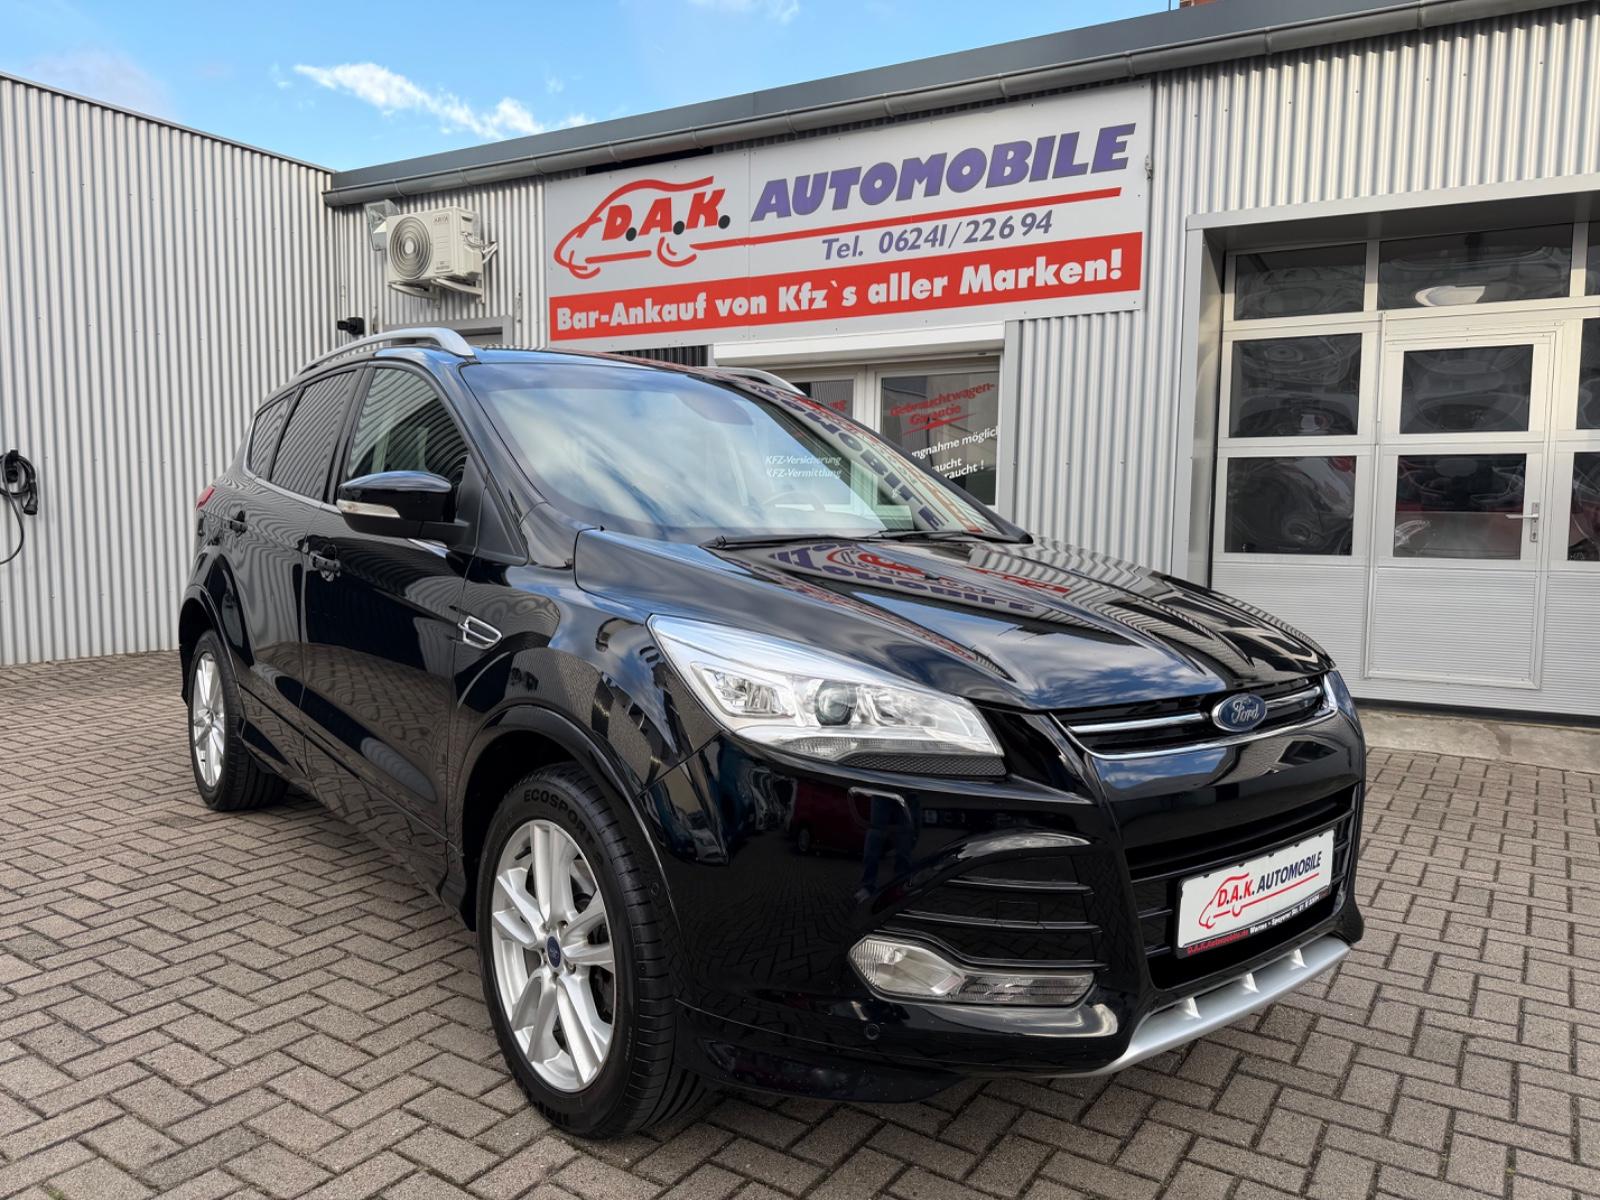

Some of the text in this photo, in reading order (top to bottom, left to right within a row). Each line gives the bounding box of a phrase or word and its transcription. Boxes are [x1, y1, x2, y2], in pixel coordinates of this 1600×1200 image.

[602, 122, 1137, 242] D.A.K. AUTOMOBILE
[822, 235, 864, 260] Tel.
[557, 292, 707, 331] Bar-Ankauf
[715, 295, 767, 317] von
[868, 271, 948, 304] aller
[959, 248, 1123, 295] Marken!
[1231, 699, 1260, 724] Ford
[523, 788, 595, 844] ECOSPORT
[1217, 851, 1322, 908] D.A.K. AUTOMOBILE
